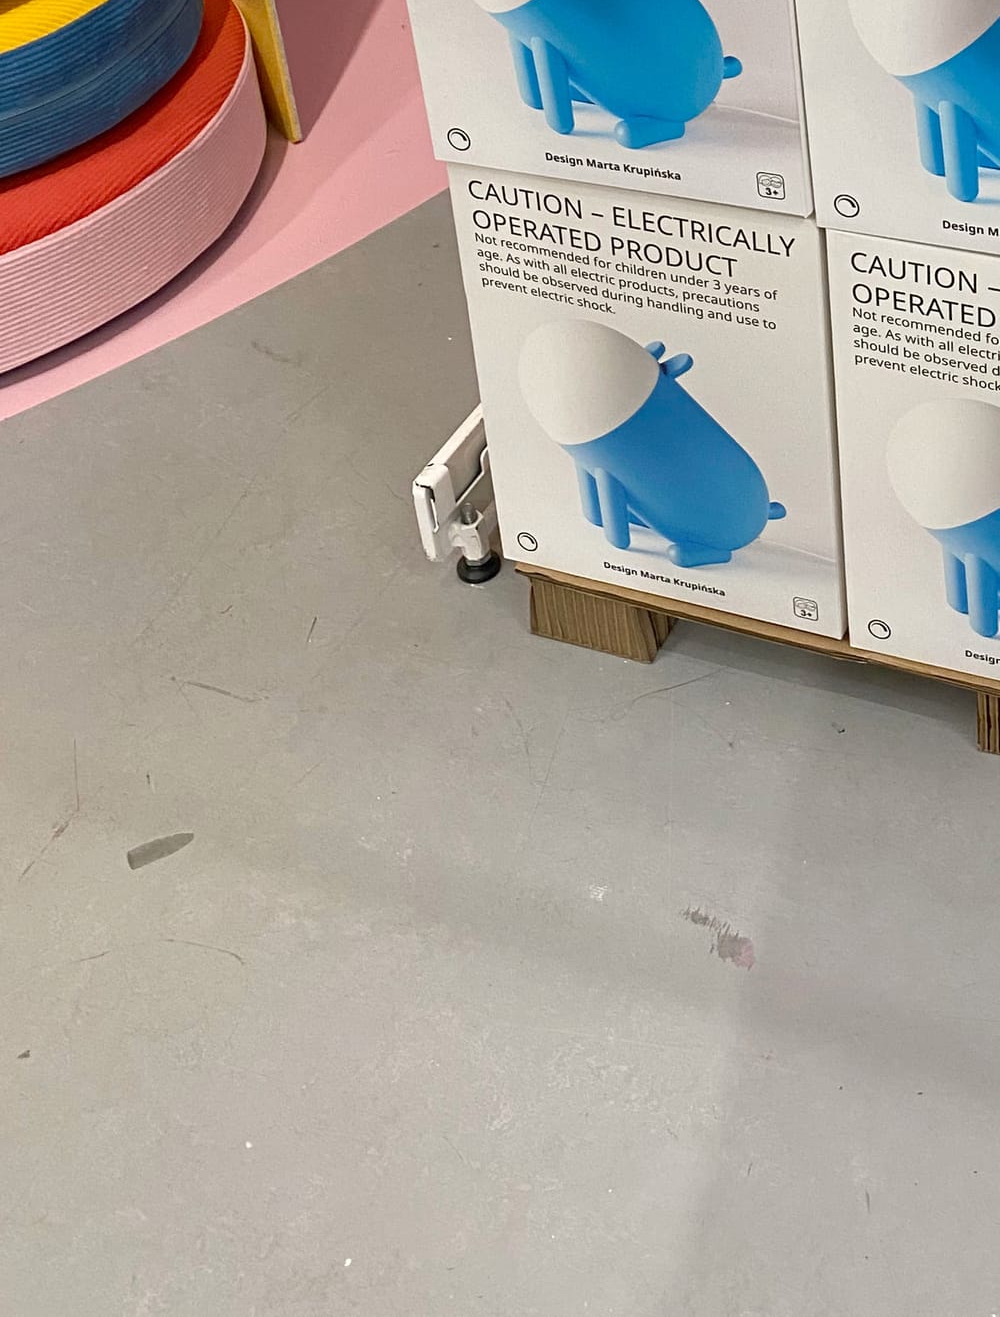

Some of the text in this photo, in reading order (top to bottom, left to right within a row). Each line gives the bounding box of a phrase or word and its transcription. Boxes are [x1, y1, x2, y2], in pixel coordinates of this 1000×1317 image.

[544, 151, 681, 181] Design Marta Krupińska
[763, 185, 779, 196] 3+
[468, 179, 582, 219] CAUTION
[612, 205, 795, 257] ELECTRICALLY
[942, 219, 984, 236] Design
[472, 209, 738, 278] OPERATED PRODUCT
[850, 251, 977, 294] CAUTION
[481, 277, 616, 315] prevent electric shock.
[852, 283, 996, 328] OPERATED
[853, 337, 899, 356] should
[903, 346, 920, 361] be
[923, 352, 987, 374] observed
[603, 561, 638, 576] Design
[639, 569, 671, 584] Marta
